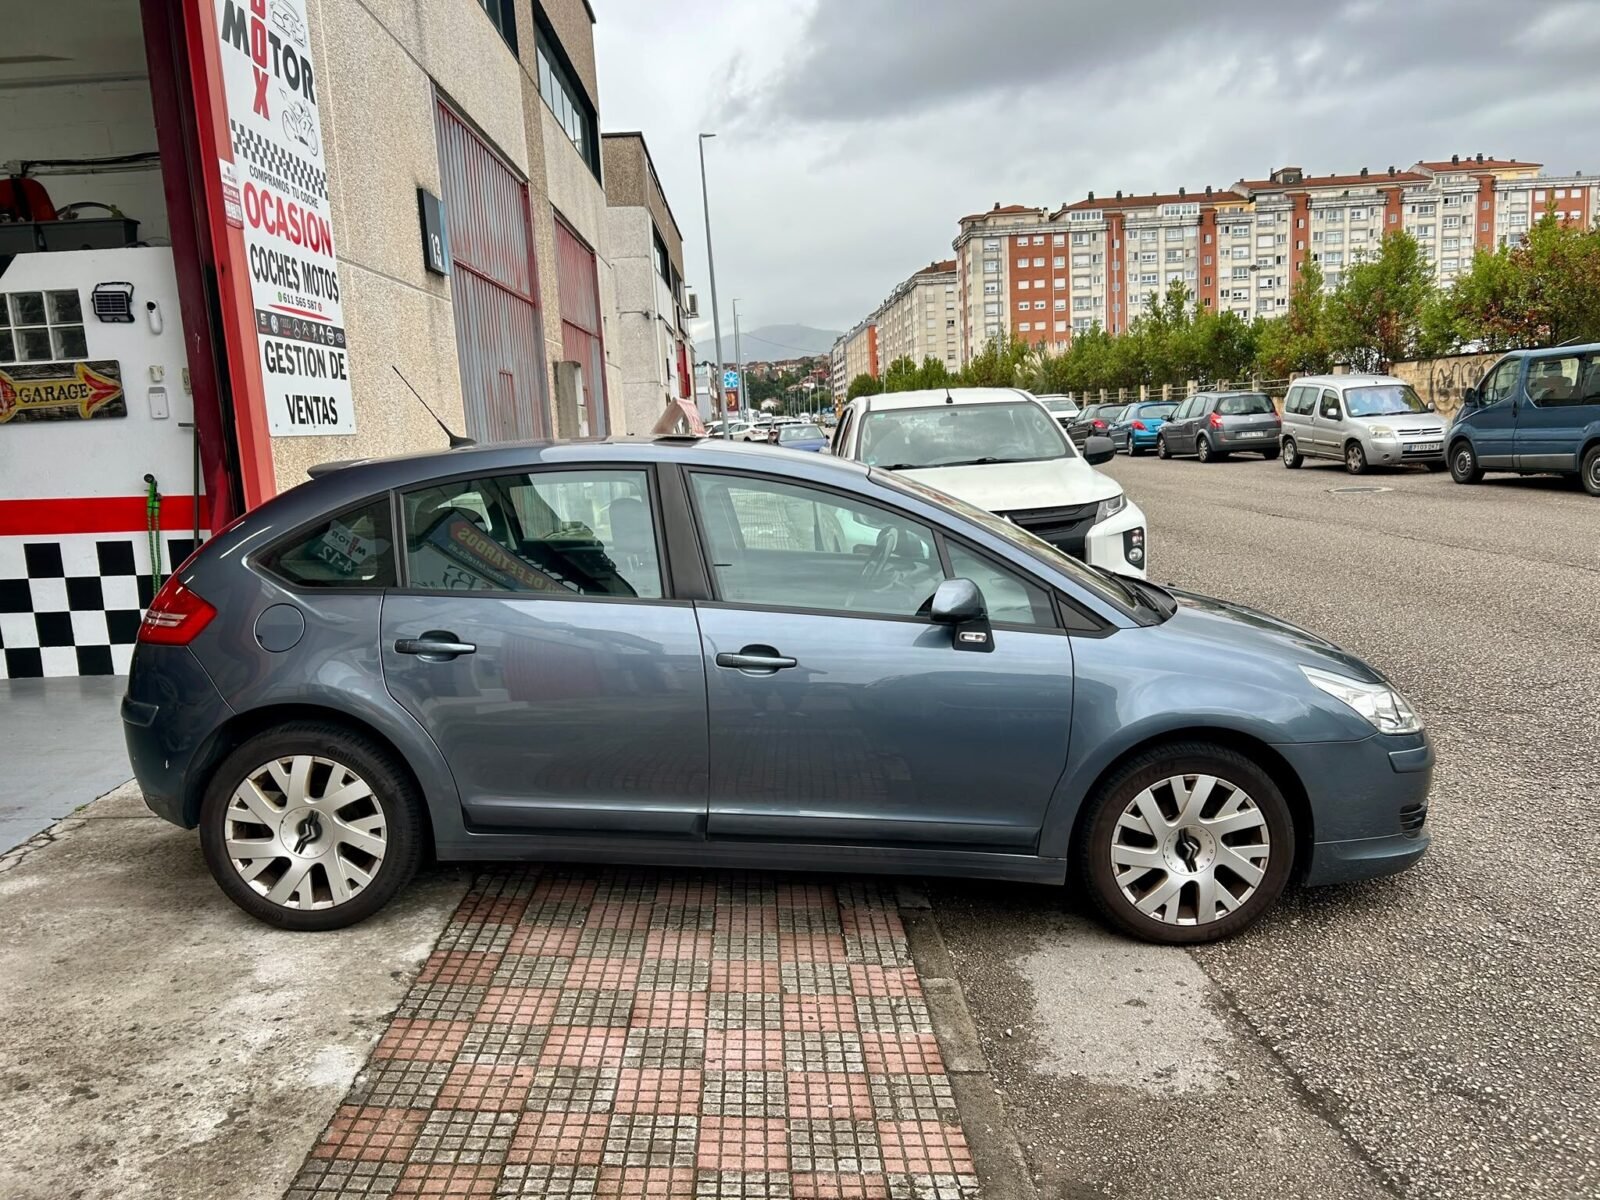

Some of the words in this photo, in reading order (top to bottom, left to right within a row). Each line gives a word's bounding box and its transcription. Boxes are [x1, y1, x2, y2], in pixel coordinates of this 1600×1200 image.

[221, 0, 316, 105] MOTOR
[249, 164, 290, 194] COMPRAMOS
[291, 185, 300, 199] TU
[300, 191, 319, 209] COCHE
[243, 181, 333, 258] OCASION
[249, 243, 300, 293] COCHES
[301, 260, 339, 304] MOTOS
[282, 292, 295, 304] 611
[264, 340, 327, 378] GESTION
[328, 351, 347, 380] DE
[19, 383, 89, 403] GARAGE
[285, 394, 338, 425] VENTAS
